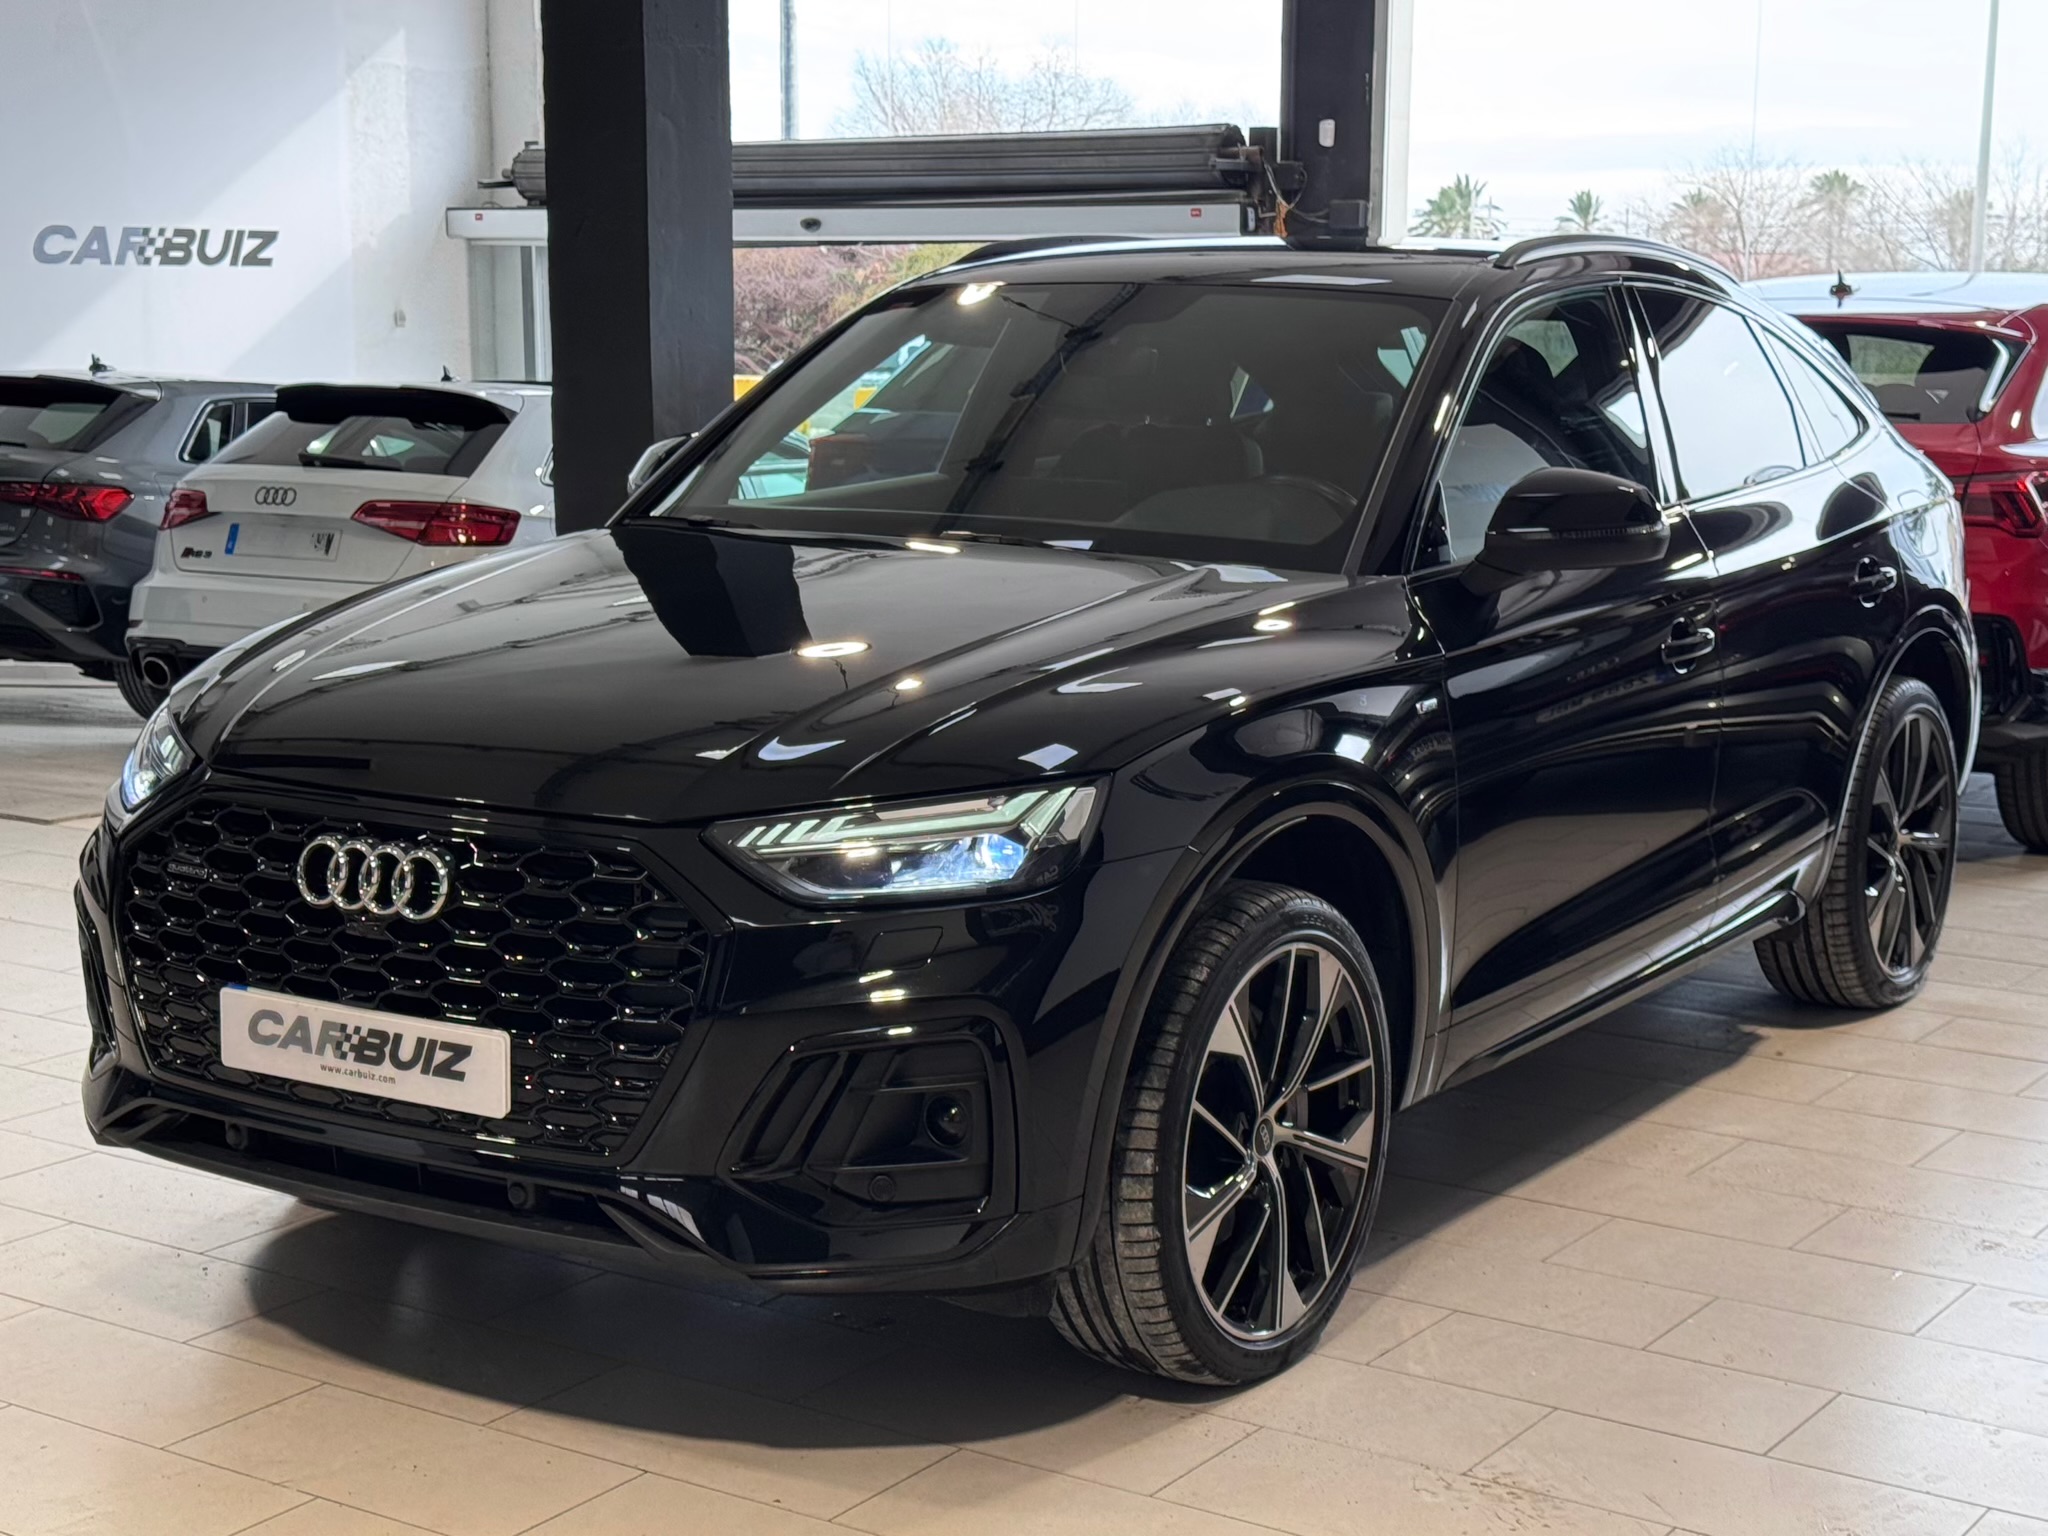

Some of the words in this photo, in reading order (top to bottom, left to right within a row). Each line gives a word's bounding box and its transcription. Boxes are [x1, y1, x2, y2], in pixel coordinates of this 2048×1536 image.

[32, 224, 280, 267] CARBUIZ
[167, 863, 206, 877] quattro
[247, 1008, 473, 1082] CARBUIZ
[320, 1063, 397, 1085] www.carbuiz.com
